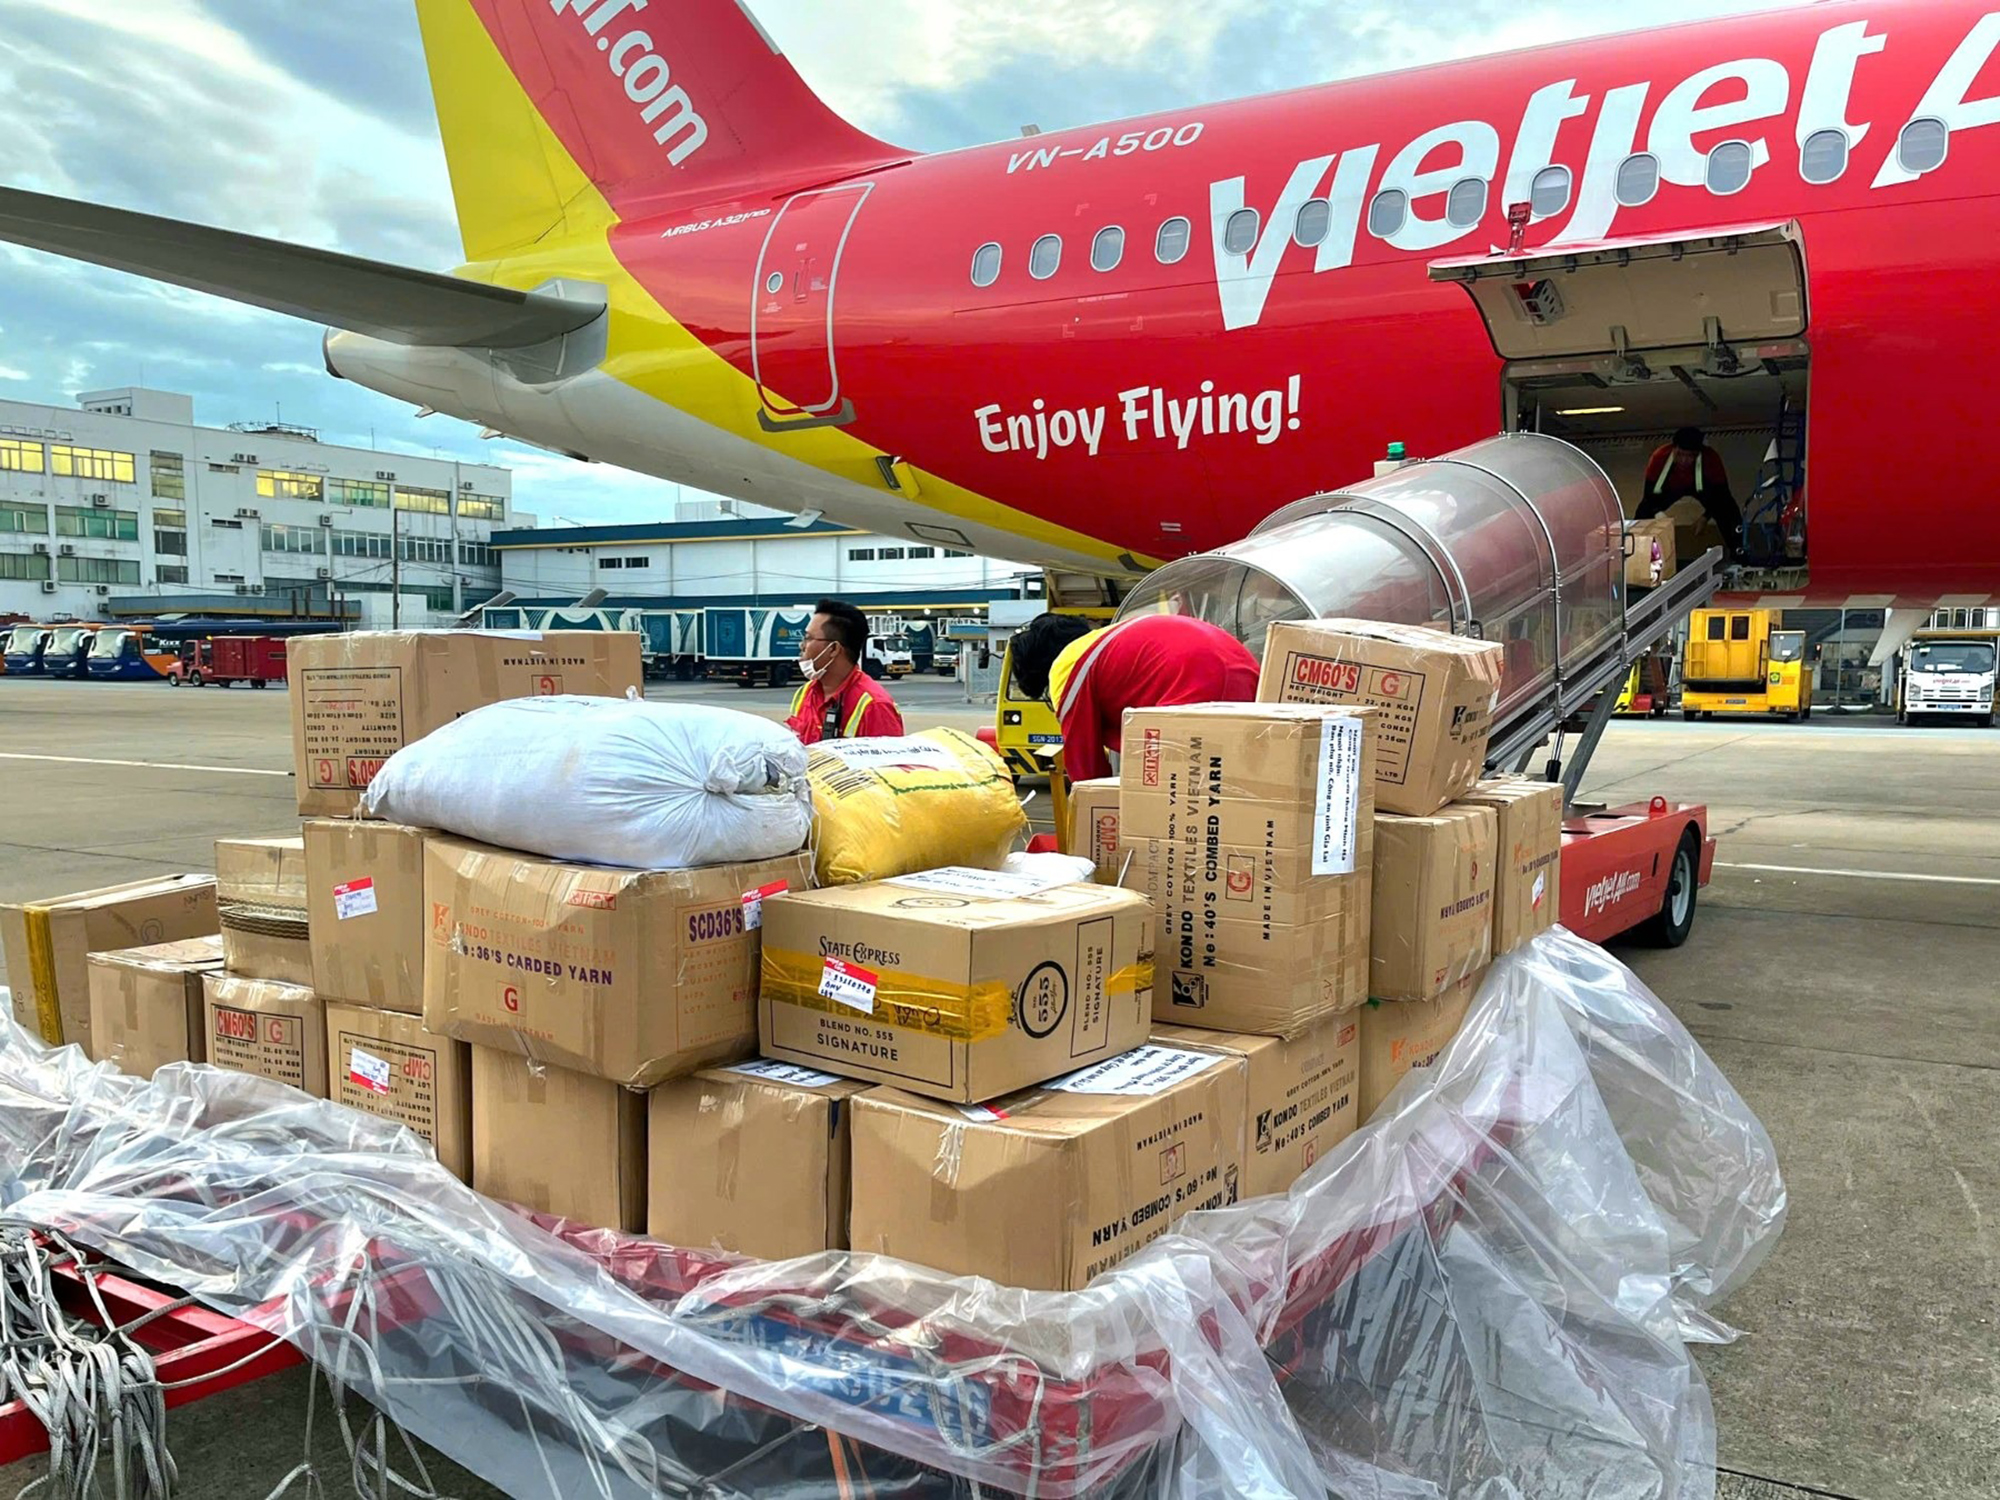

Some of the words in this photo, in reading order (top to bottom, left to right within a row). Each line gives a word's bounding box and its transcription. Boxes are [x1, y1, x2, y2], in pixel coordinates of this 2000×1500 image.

[1006, 120, 1205, 174] VN-A500
[660, 217, 711, 239] AIRBUS
[974, 397, 1106, 461] Enjoy
[1117, 373, 1301, 450] Flying!
[502, 658, 547, 667] VIETNAM
[548, 657, 558, 666] IN
[561, 657, 586, 666] MADE
[1296, 658, 1359, 691] CM60'S
[540, 676, 556, 696] G
[1289, 684, 1306, 693] NET
[1310, 687, 1344, 699] WEIGHT
[1397, 702, 1415, 712] KGS
[1380, 672, 1400, 695] G
[1287, 694, 1316, 705] GROSS
[1394, 713, 1413, 723] KGS
[1380, 722, 1411, 733] CONES
[319, 759, 333, 783] G
[1186, 736, 1203, 817] VIETNAM
[1208, 756, 1222, 807] YARN
[1101, 814, 1117, 853] CMP
[1205, 814, 1220, 882] COMBED
[1165, 902, 1173, 935] GREY
[1169, 772, 1177, 806] YARN
[1182, 825, 1198, 904] TEXTILES
[1263, 819, 1275, 882] VIETNAM
[1226, 870, 1252, 893] G
[1264, 885, 1272, 900] IN
[688, 906, 744, 943] SCD36'S
[1262, 904, 1272, 941] MADE
[1180, 910, 1193, 968] KONDO
[506, 952, 563, 977] CARDED
[568, 963, 613, 986] YARN
[1085, 970, 1093, 990] NO.
[503, 987, 519, 1013] G
[1037, 976, 1050, 1023] 555
[1092, 947, 1104, 1024] SIGNATURE
[217, 1010, 255, 1040] CM60'S
[1082, 994, 1092, 1032] BLEND
[227, 1039, 250, 1049] WEIGHT
[269, 1020, 284, 1043] G
[819, 1018, 851, 1033] BLEND
[854, 1025, 872, 1037] NO.
[876, 1030, 894, 1042] 555
[817, 1033, 899, 1061] SIGNATURE
[402, 1057, 432, 1081] CMP
[395, 1100, 431, 1113] QUANTITY
[1273, 1103, 1298, 1129] KONDO
[1299, 1085, 1329, 1115] TEXTILES
[1329, 1070, 1356, 1096] VIETNAM
[1307, 1108, 1331, 1132] COMBED
[1332, 1094, 1350, 1116] YARN
[1172, 1122, 1183, 1132] IN
[1183, 1111, 1203, 1126] MADE
[1136, 1126, 1174, 1151] VIETNAM
[1131, 1193, 1172, 1227] COMBED
[1092, 1218, 1128, 1247] YARN
